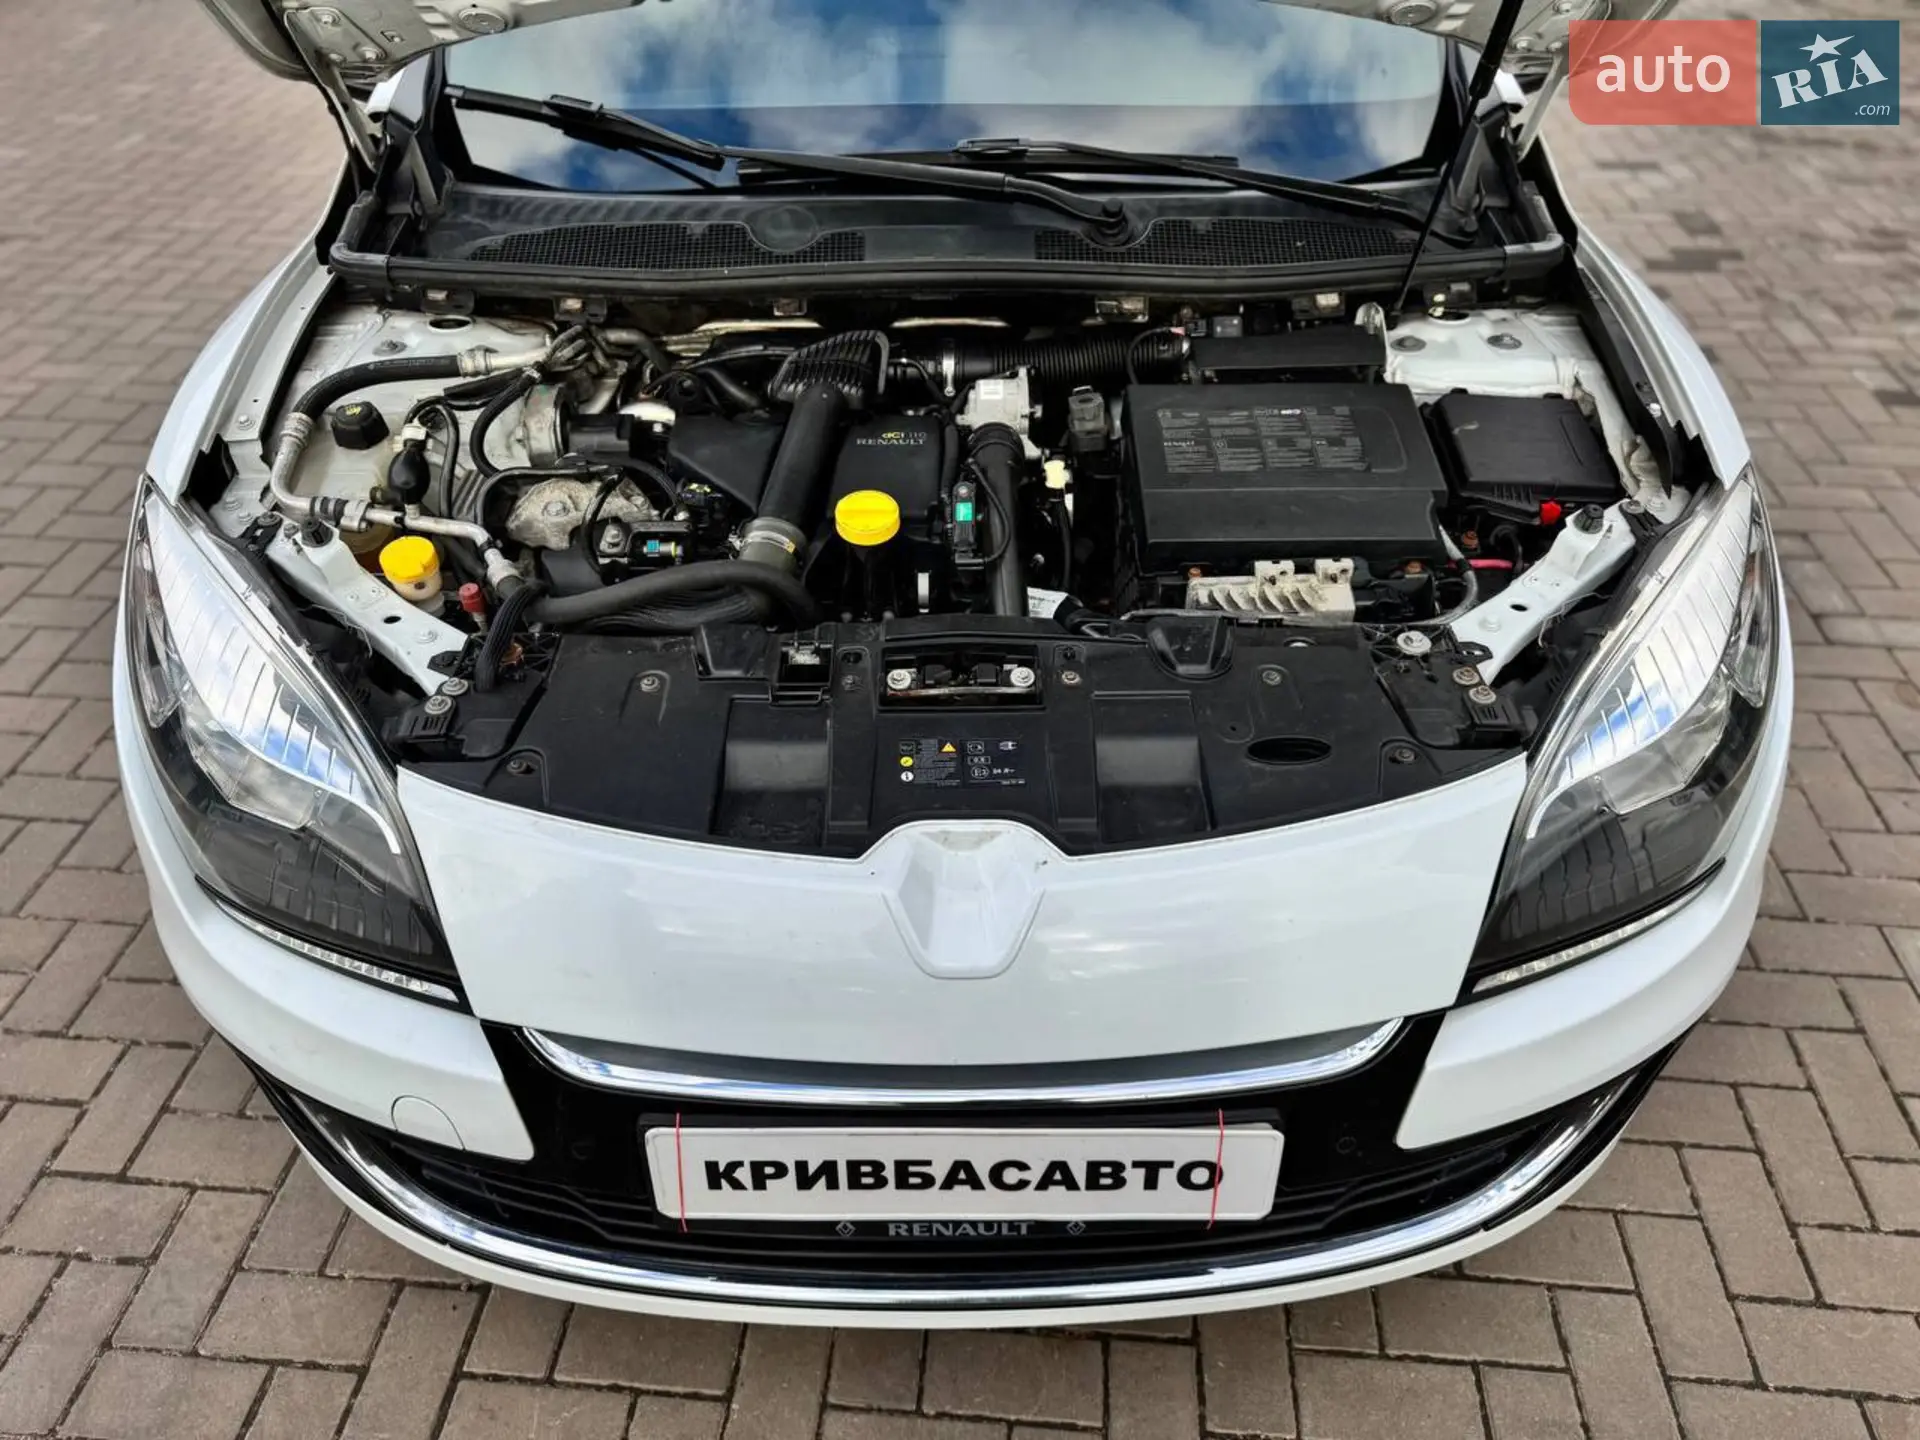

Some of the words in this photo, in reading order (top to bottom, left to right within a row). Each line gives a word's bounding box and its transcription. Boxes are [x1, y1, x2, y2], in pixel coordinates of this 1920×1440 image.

[856, 438, 924, 446] RENAULT
[704, 1158, 1223, 1192] КРИВБАСАВТО
[887, 1221, 1035, 1237] RENAULT
